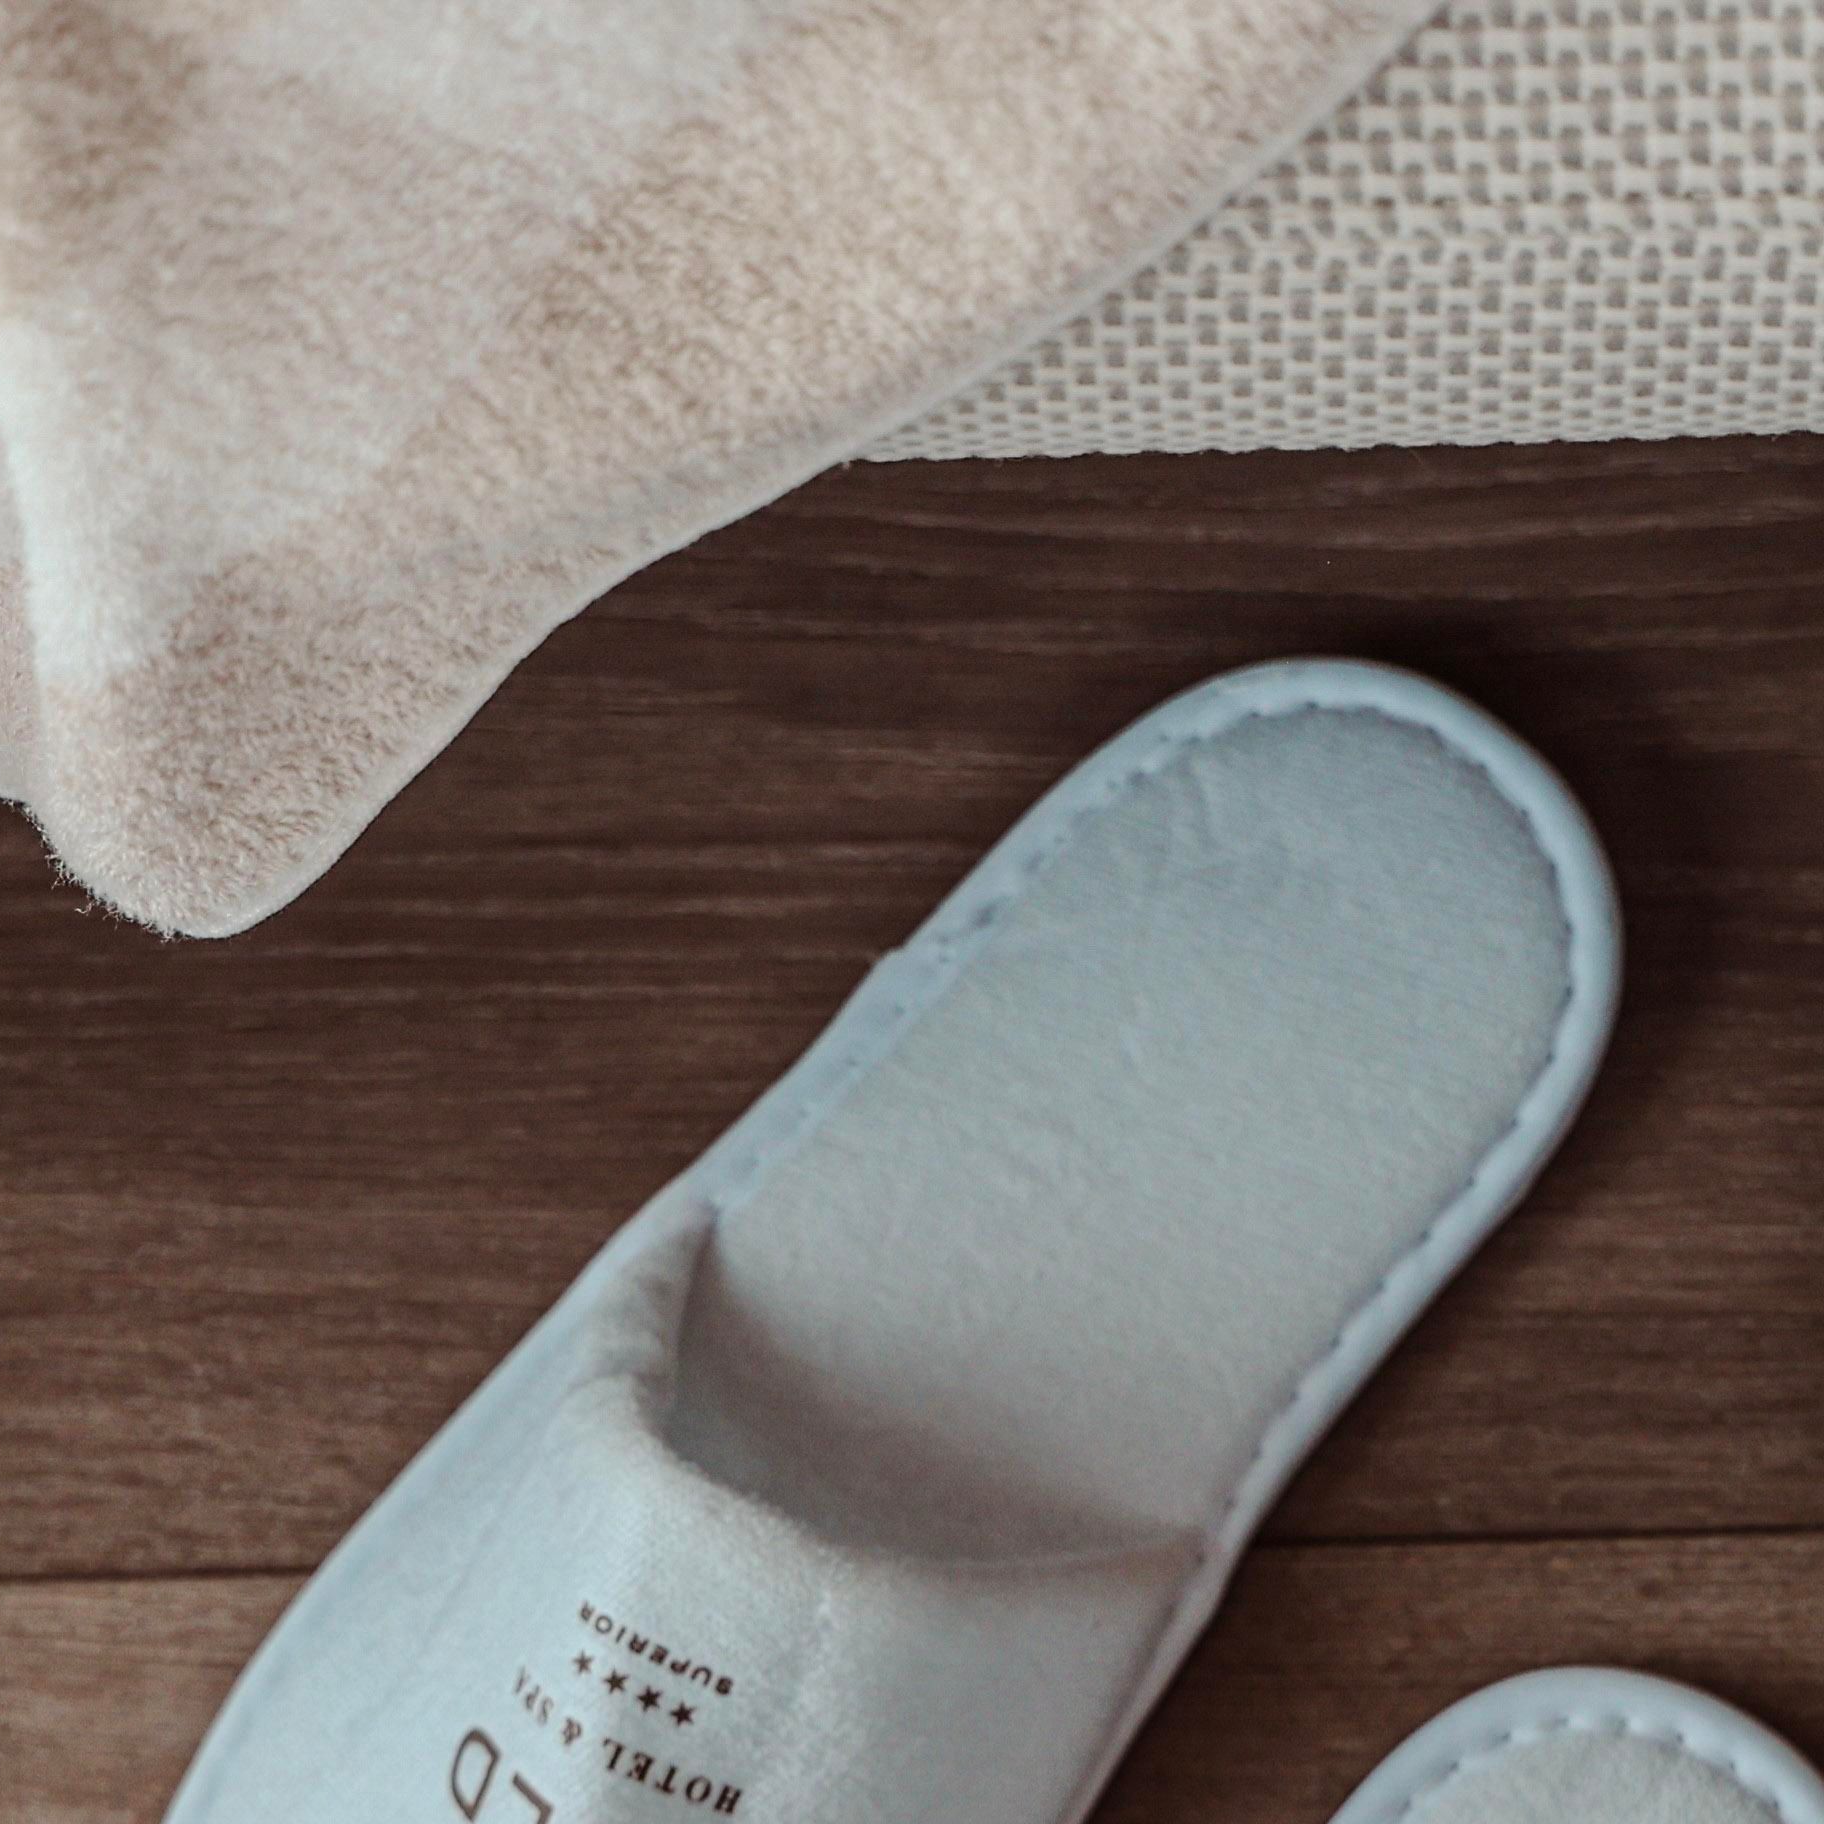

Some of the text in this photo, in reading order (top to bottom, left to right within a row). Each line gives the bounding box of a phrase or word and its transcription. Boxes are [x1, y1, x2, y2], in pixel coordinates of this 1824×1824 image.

[580, 1601, 734, 1697] SUPERIOR
[511, 1664, 742, 1815] HOTEL & SPA
